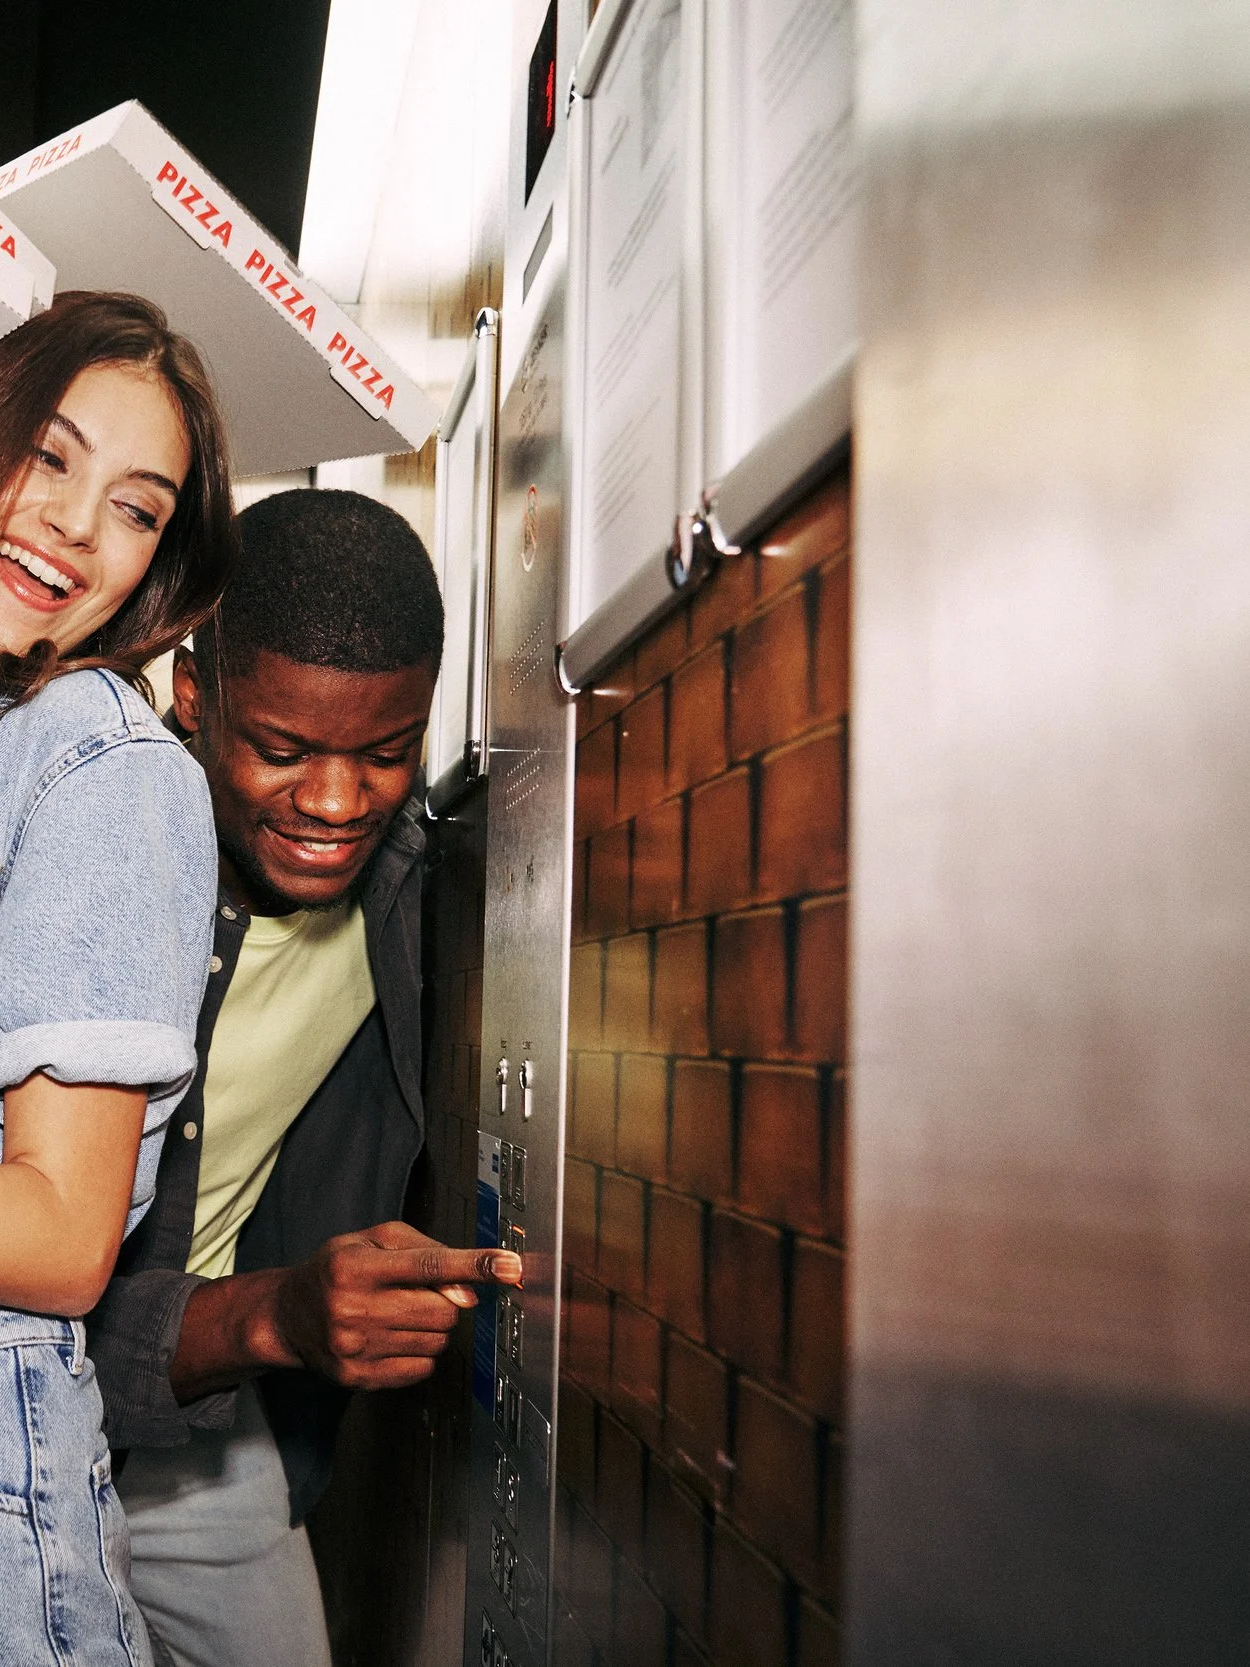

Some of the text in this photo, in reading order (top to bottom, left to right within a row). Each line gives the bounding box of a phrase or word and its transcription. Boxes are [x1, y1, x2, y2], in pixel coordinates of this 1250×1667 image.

[25, 133, 83, 177] PIZZA
[155, 159, 396, 409] PIZZA PIZZA PIZZA
